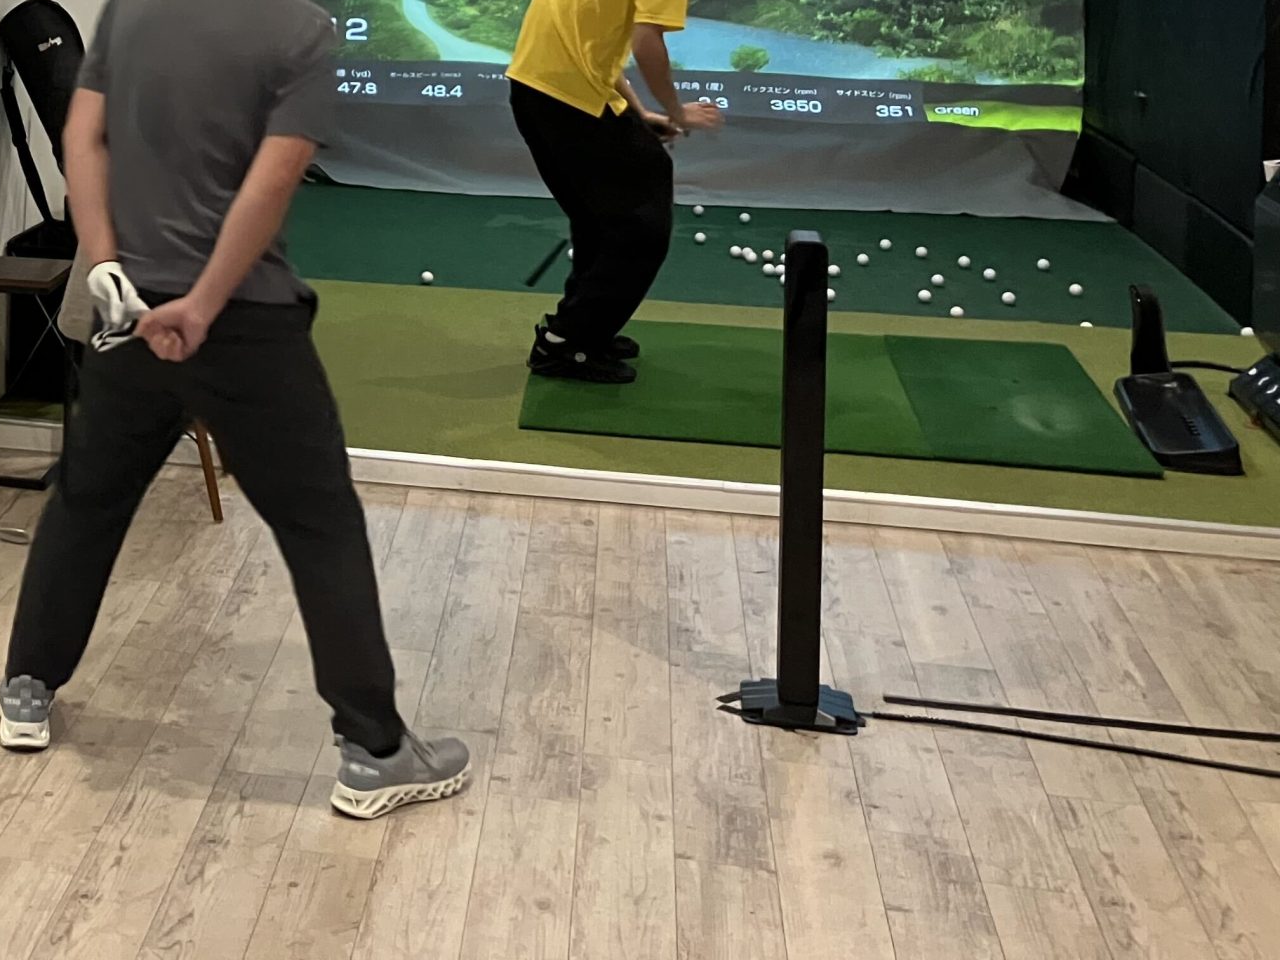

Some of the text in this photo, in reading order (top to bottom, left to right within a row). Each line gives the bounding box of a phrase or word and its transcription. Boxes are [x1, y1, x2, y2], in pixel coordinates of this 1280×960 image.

[337, 81, 377, 95] 47.8
[421, 84, 463, 98] 48.4
[769, 99, 822, 114] 3650
[875, 104, 914, 118] 351
[934, 105, 980, 117] Green
